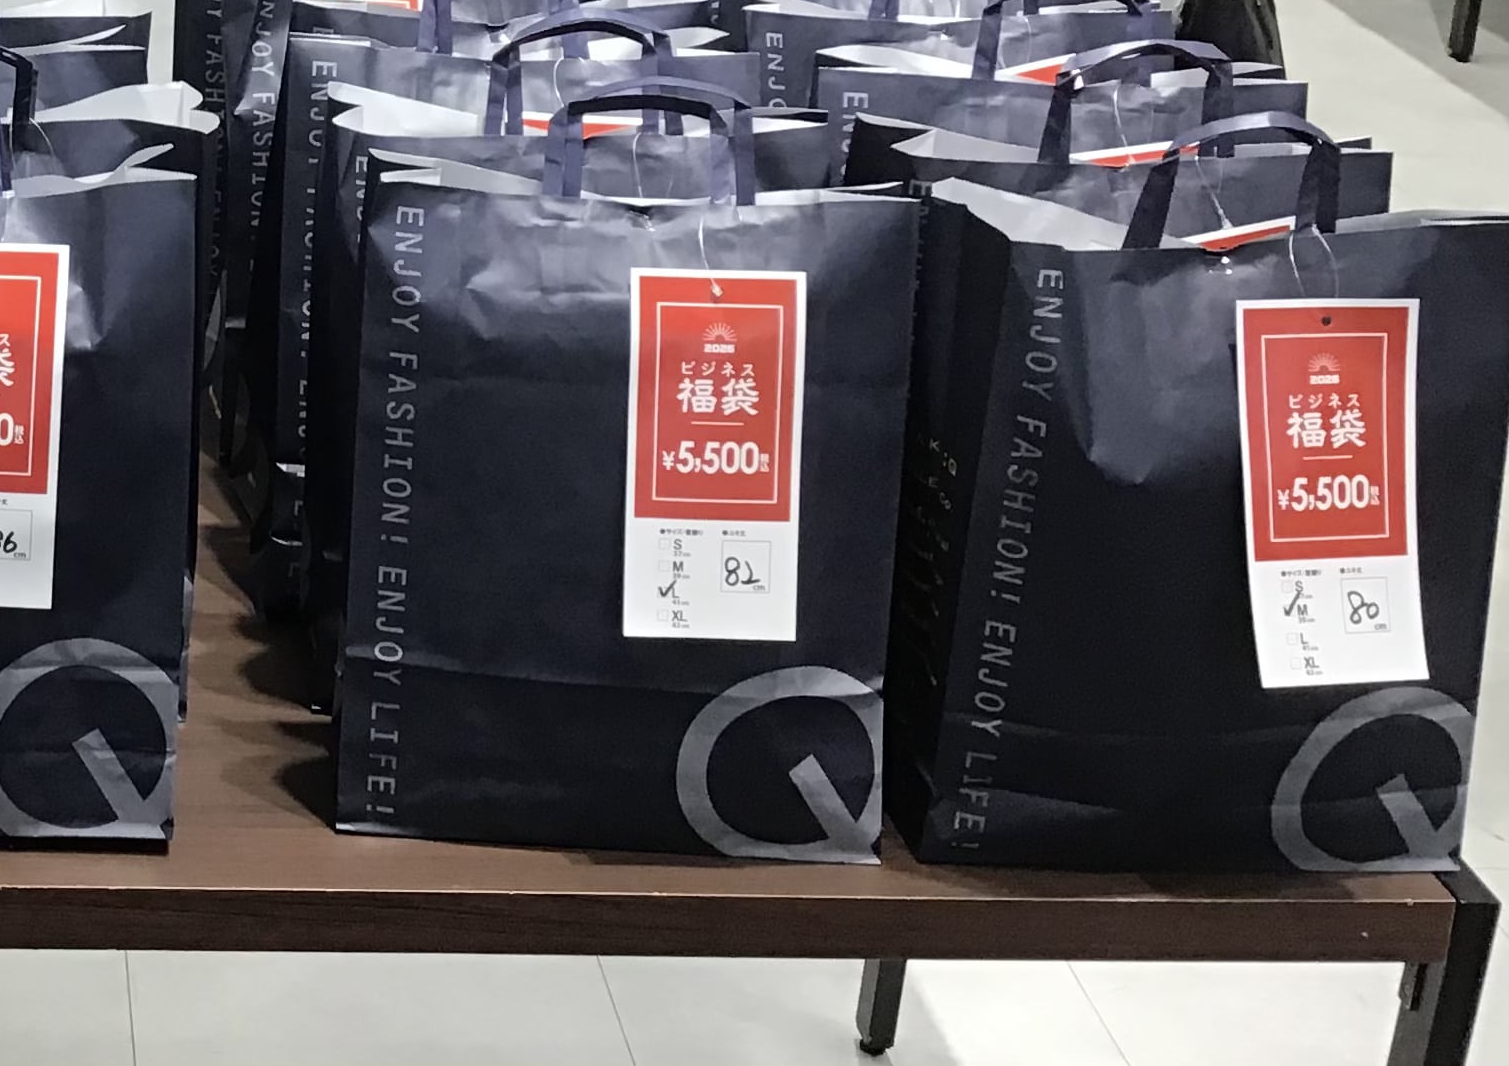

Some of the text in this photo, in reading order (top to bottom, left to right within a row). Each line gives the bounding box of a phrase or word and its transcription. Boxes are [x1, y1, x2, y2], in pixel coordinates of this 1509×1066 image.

[681, 361, 755, 377] ビジネス
[676, 377, 760, 416] 福袋
[1288, 393, 1361, 409] ビジネス
[1286, 409, 1367, 449] 福袋
[366, 205, 425, 814] ENJOY FASHION! ENJOY LIFE!
[673, 539, 682, 550] S
[951, 268, 1065, 850] ENJOY FASHION! ENJOY LIFE!
[672, 561, 684, 572] M
[724, 556, 761, 586] 82
[672, 587, 679, 598] L
[1295, 580, 1304, 592] S
[1297, 604, 1308, 616] M
[1347, 590, 1380, 624] 80
[671, 610, 687, 621] XL
[1300, 633, 1308, 644] L
[1303, 656, 1320, 668] XL
